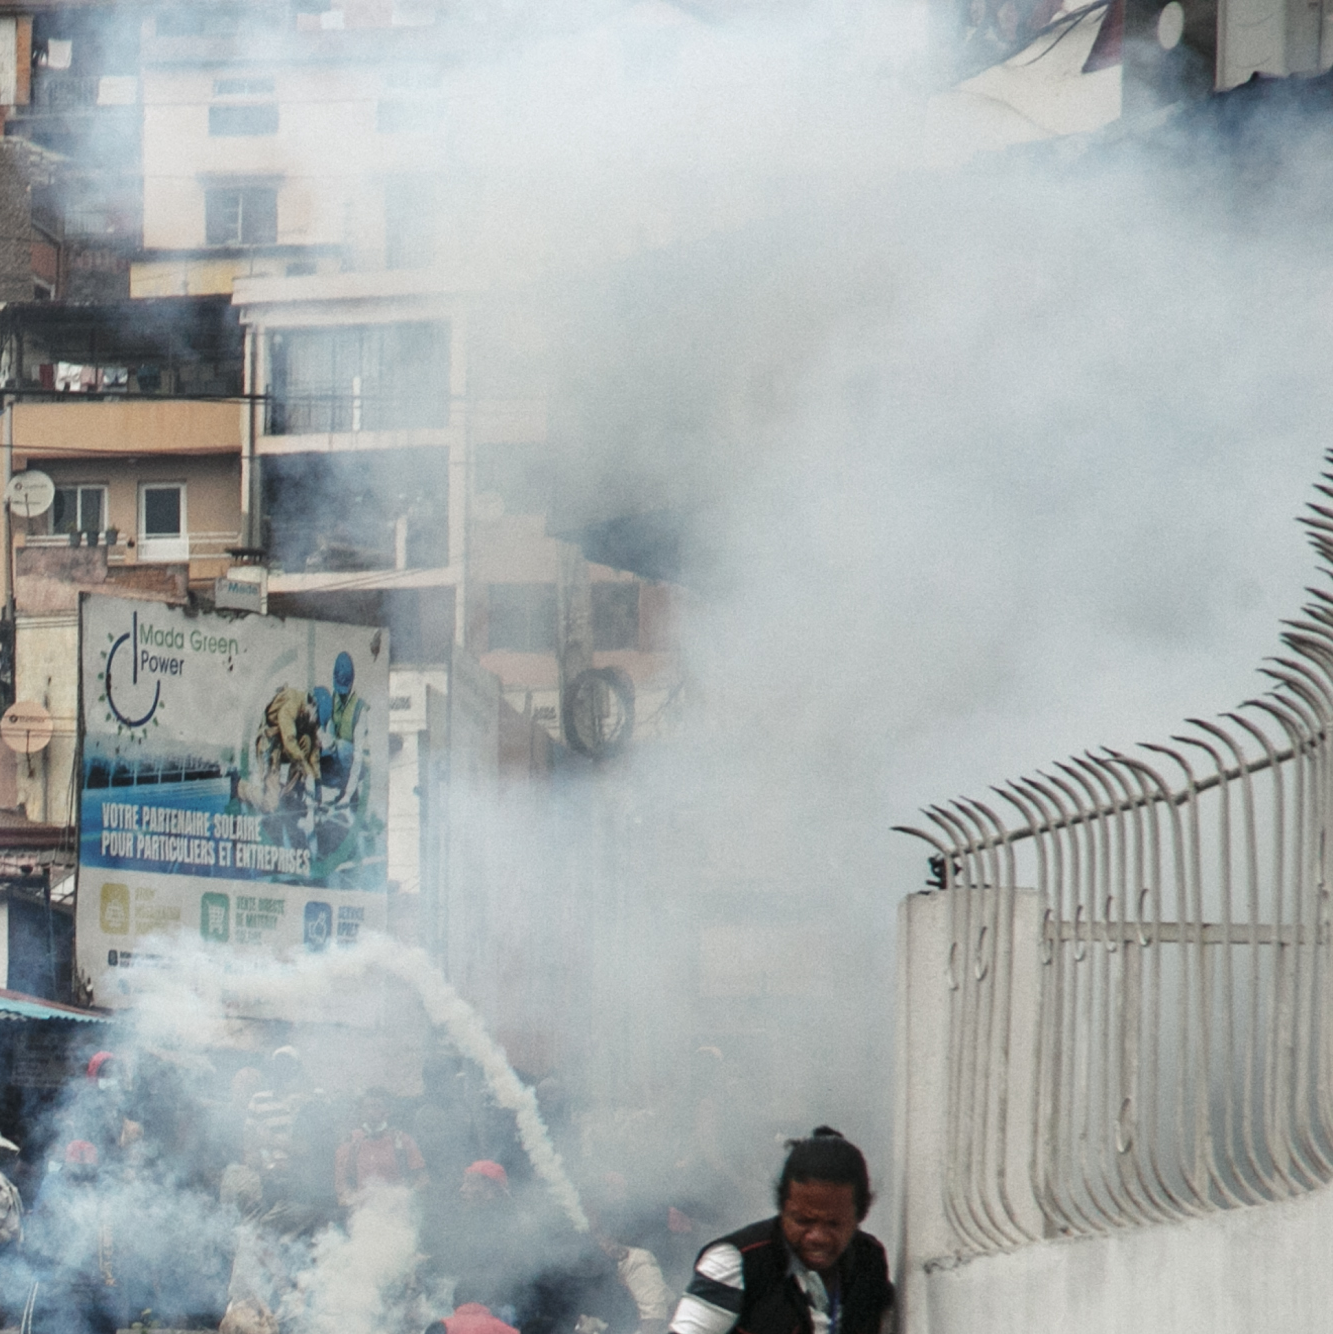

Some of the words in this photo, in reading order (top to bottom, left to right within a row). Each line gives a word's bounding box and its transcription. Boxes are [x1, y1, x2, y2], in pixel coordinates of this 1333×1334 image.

[140, 623, 184, 649] Mada
[190, 630, 238, 655] Green
[141, 650, 184, 676] Power
[102, 802, 139, 830] VOTRE
[142, 806, 210, 837] PARTENAIRE
[214, 813, 261, 841] SOLAIRE
[101, 831, 133, 858] POUR
[136, 834, 215, 865] PARTICULIERS
[218, 841, 232, 867] ET
[236, 844, 311, 875] ENTREPRISES
